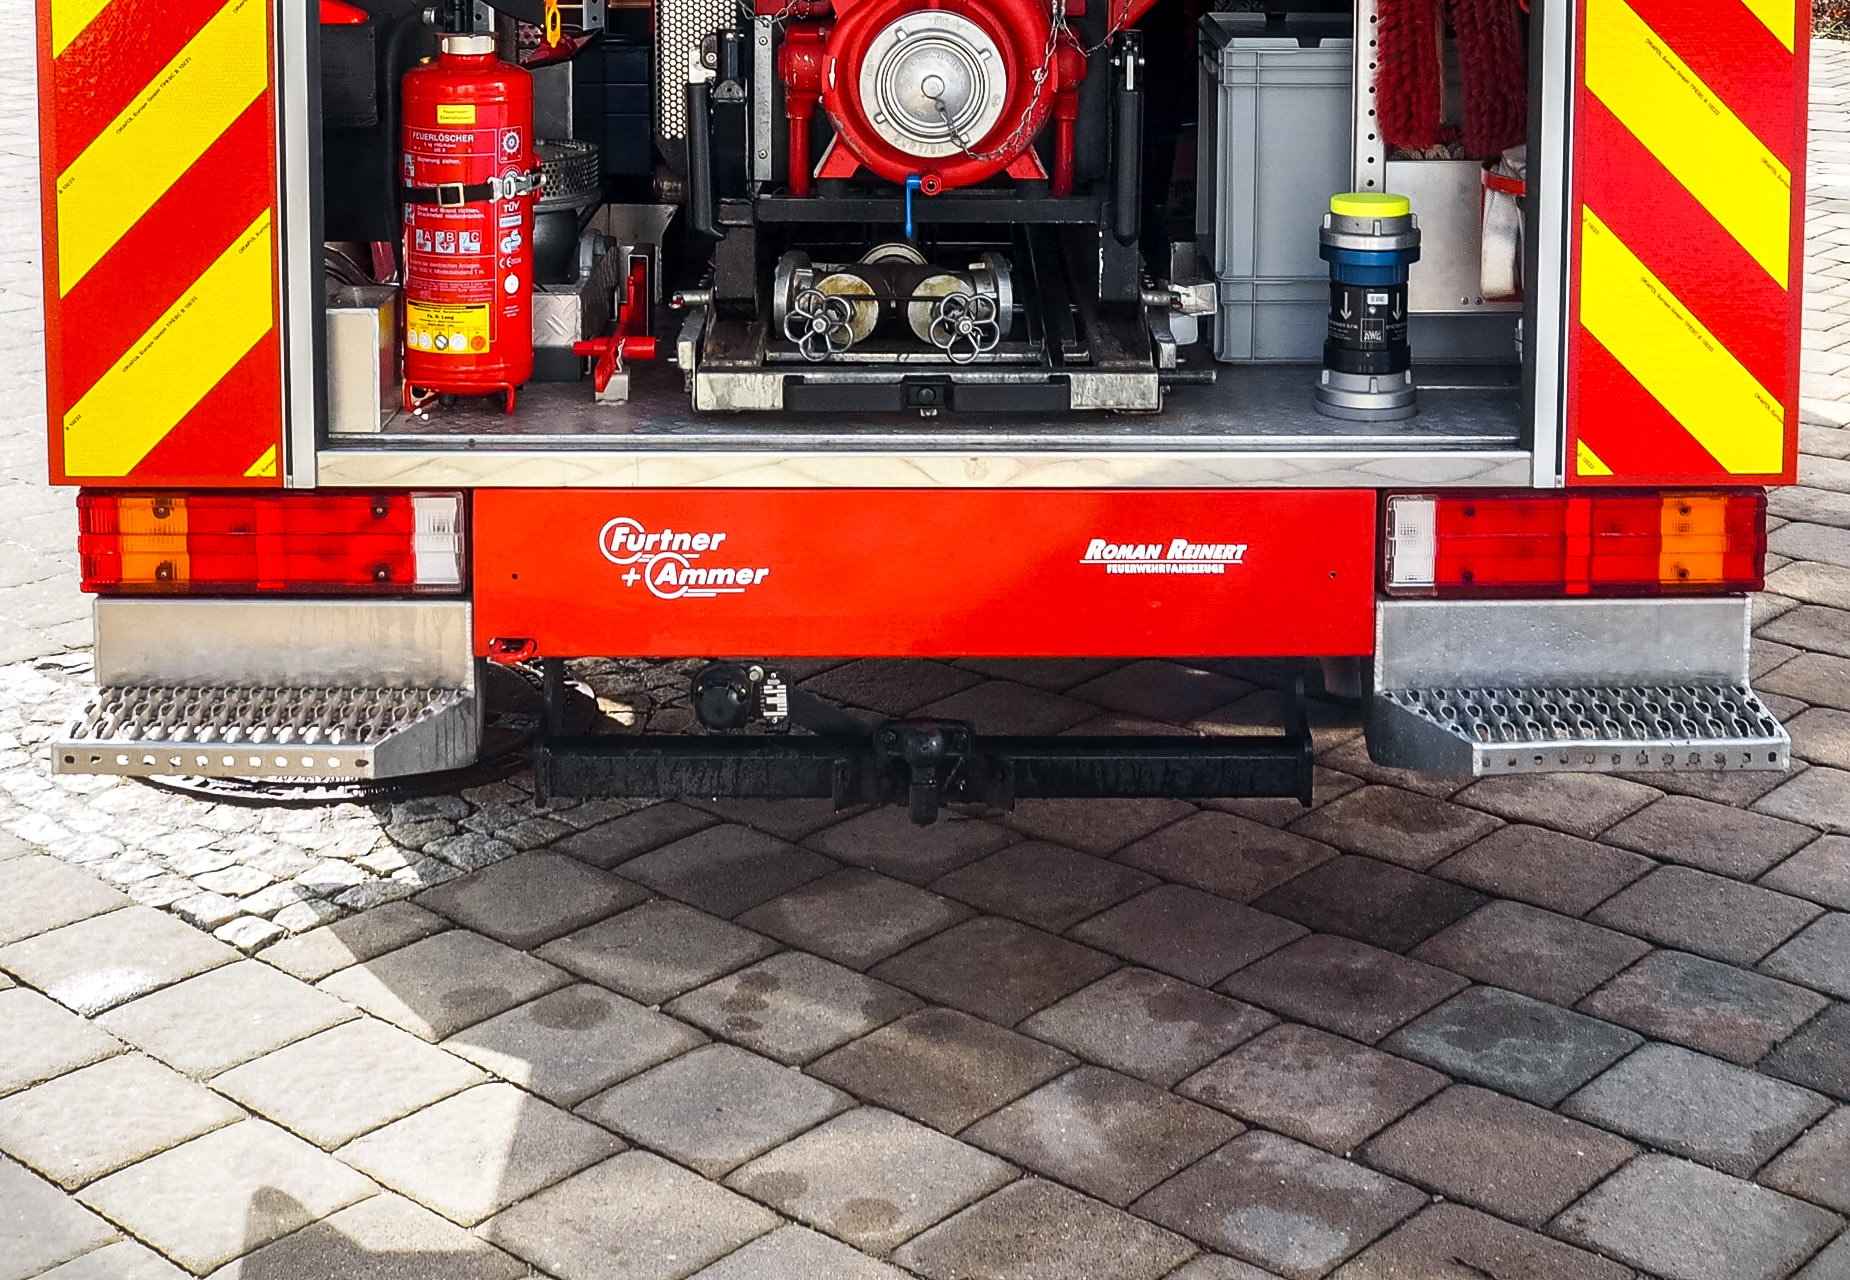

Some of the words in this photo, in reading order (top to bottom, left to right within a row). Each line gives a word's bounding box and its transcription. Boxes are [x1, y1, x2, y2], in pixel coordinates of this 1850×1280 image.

[412, 131, 474, 143] FEUERLÖSCHER
[503, 200, 520, 213] TÜV
[424, 230, 432, 241] A
[446, 232, 455, 242] B
[470, 232, 480, 242] C
[1363, 330, 1382, 341] AWG
[611, 526, 727, 552] Furtner
[1084, 538, 1163, 560] ROMAN
[1166, 538, 1248, 560] REINERT
[654, 562, 770, 586] Ammer
[1106, 564, 1226, 574] FEUERWEHRFAHRZEUGE
